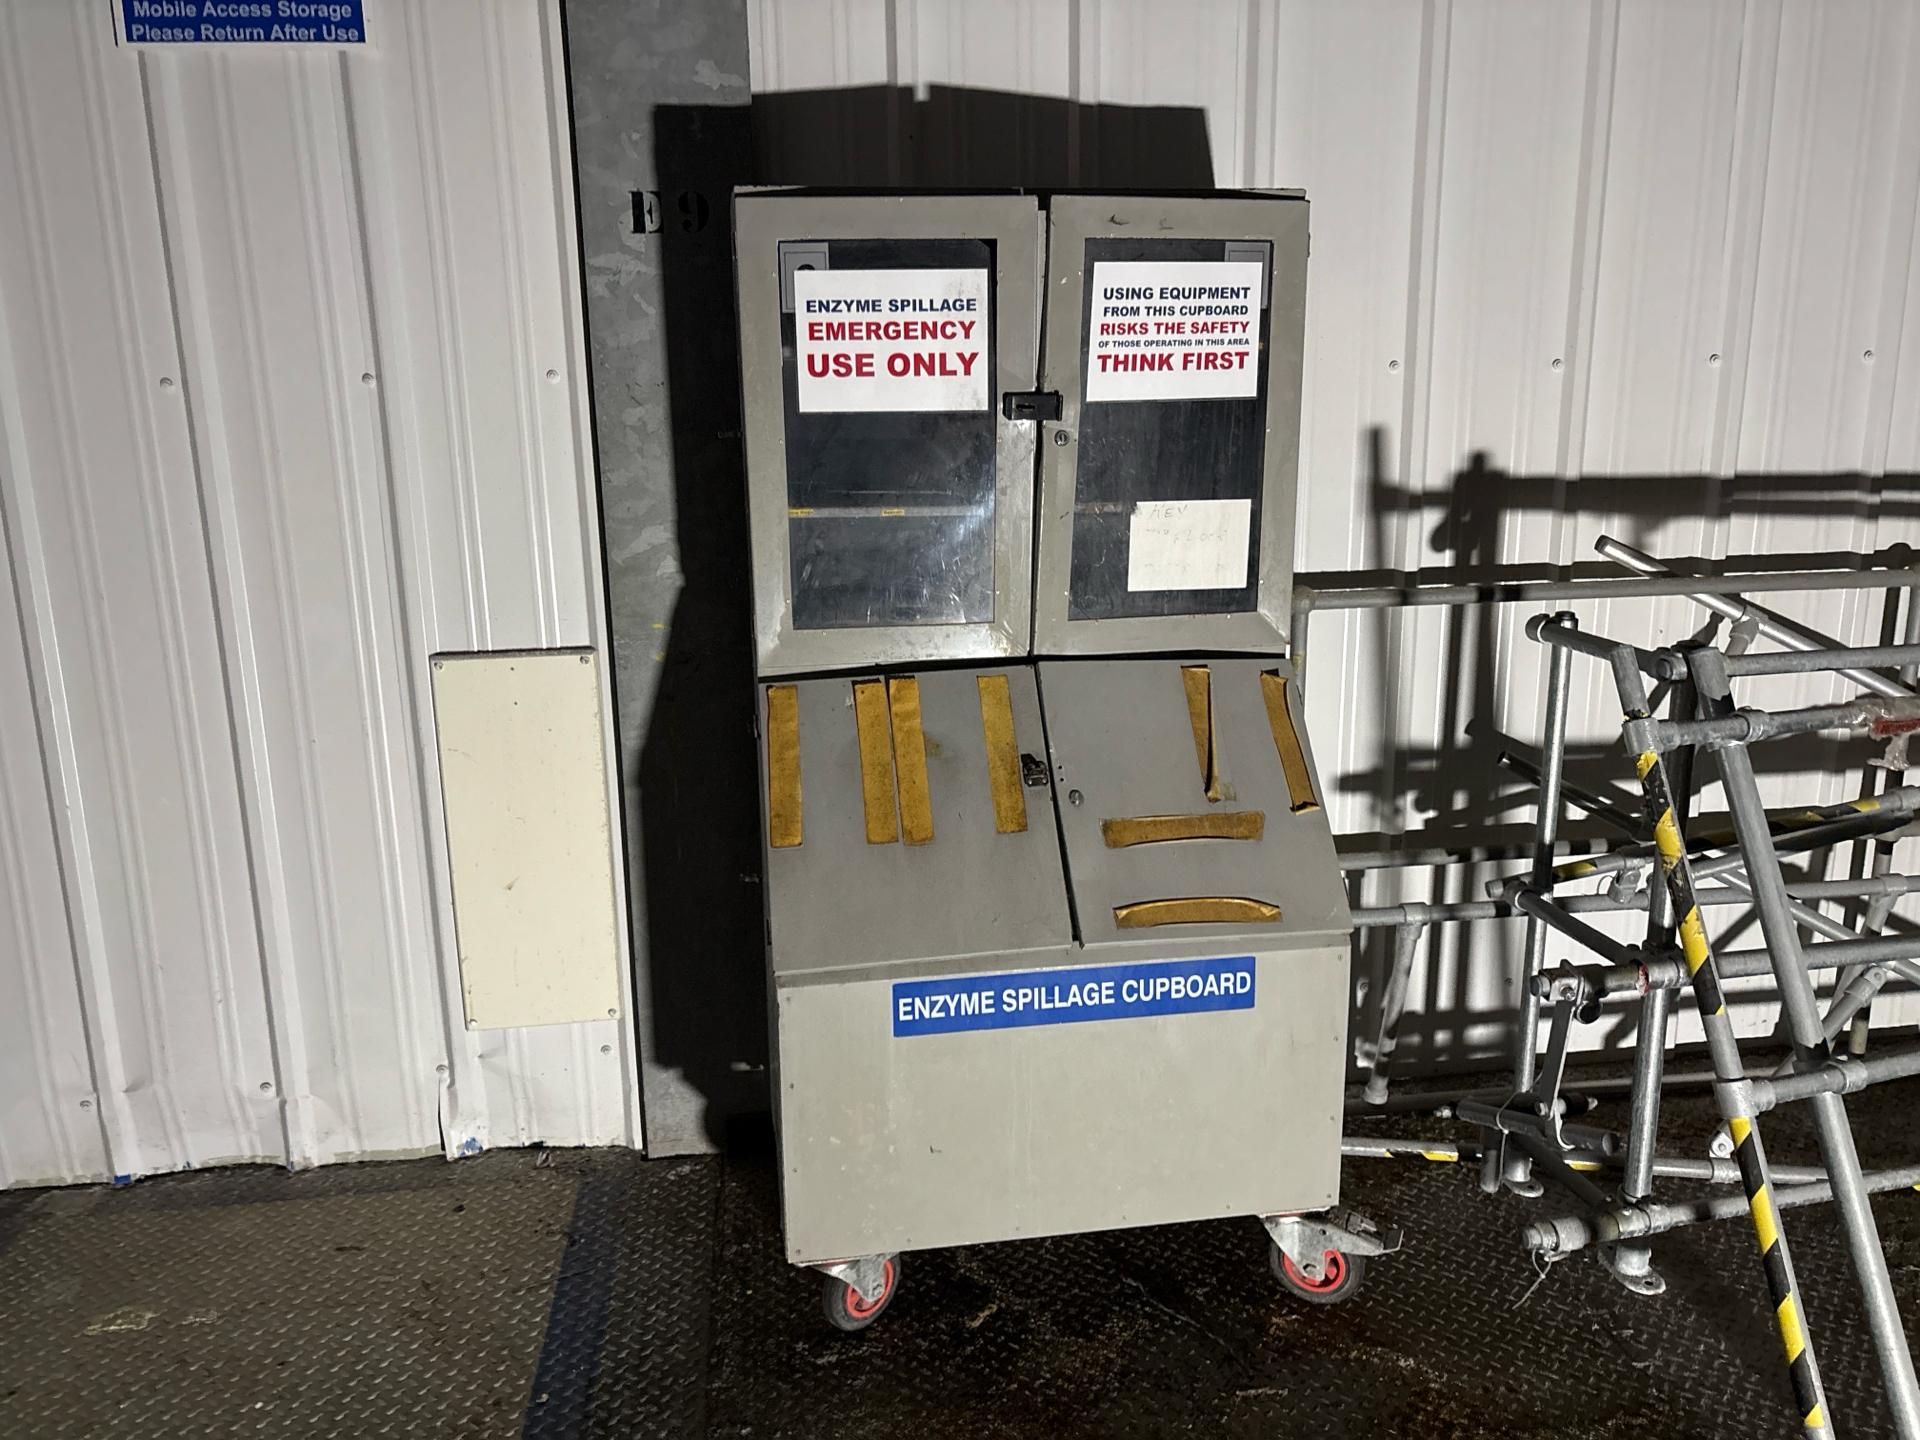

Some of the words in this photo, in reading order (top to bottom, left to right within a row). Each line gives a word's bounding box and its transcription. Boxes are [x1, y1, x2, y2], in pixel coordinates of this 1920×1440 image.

[133, 0, 197, 18] Mobile
[203, 0, 272, 18] Access
[278, 0, 352, 22] Storage
[131, 24, 195, 41] Please
[201, 24, 264, 41] Return
[270, 24, 316, 41] After
[322, 25, 359, 41] Use
[1103, 287, 1154, 301] USING
[1159, 287, 1251, 301] EQUIPMENT
[805, 299, 882, 313] ENZYME
[888, 298, 977, 312] SPILLAGE
[1103, 306, 1140, 317] FROM
[1145, 306, 1175, 317] THIS
[1179, 305, 1249, 316] CUPBOARD
[808, 320, 977, 341] EMERGENCY
[1100, 322, 1149, 336] RISKS
[1154, 322, 1185, 335] THE
[1190, 321, 1250, 335] SAFETY
[1112, 340, 1142, 348] THOSE
[1143, 339, 1193, 347] OPERATING
[1194, 339, 1204, 347] IN
[1206, 338, 1225, 346] THIS
[1227, 338, 1250, 346] AREA
[806, 353, 875, 378] USE
[886, 351, 979, 377] ONLY
[1097, 352, 1175, 373] THINK
[1182, 351, 1250, 371] FIRST
[897, 990, 996, 1022] ENZYME
[1002, 981, 1115, 1014] SPILLAGE
[1121, 971, 1252, 1004] CUPBOARD
